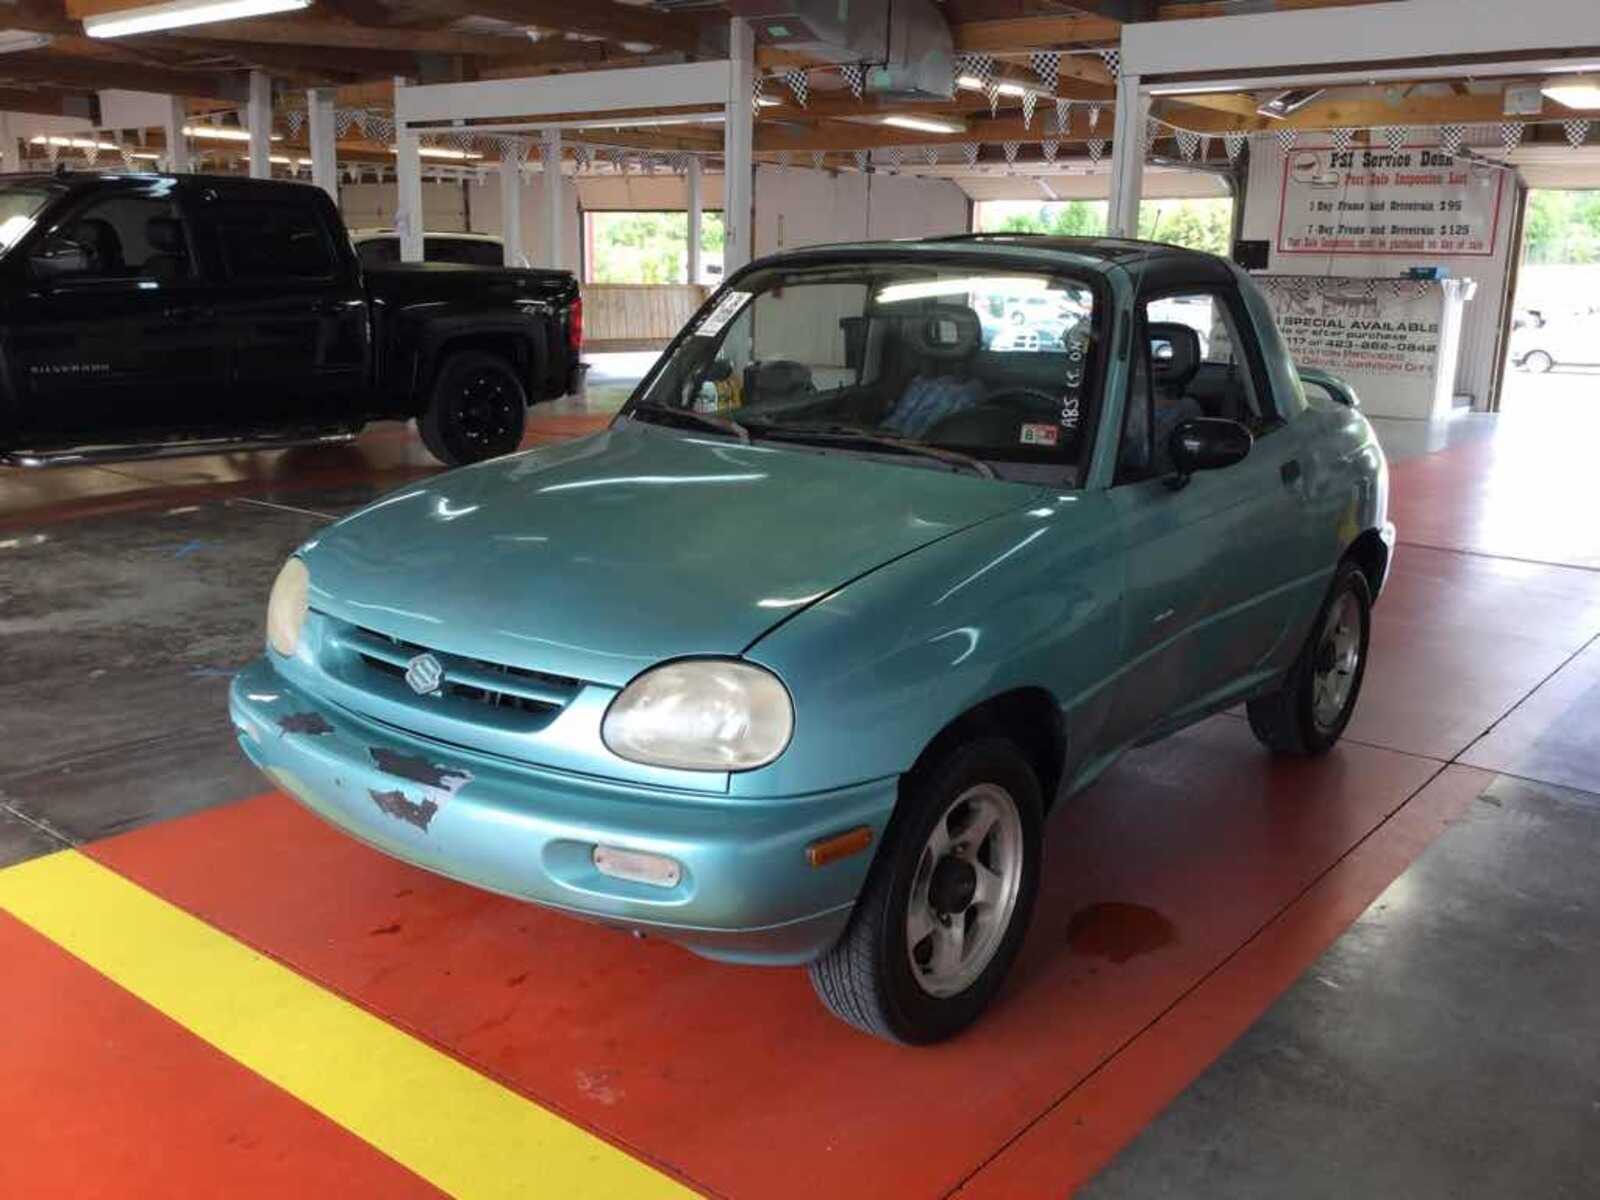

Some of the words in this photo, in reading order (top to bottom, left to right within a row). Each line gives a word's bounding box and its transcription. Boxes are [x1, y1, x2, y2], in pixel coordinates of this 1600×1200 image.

[1362, 151, 1411, 168] Service
[1284, 316, 1346, 329] SPECIAL
[1350, 321, 1439, 333] AVAILABLE
[1061, 396, 1080, 427] ABS
